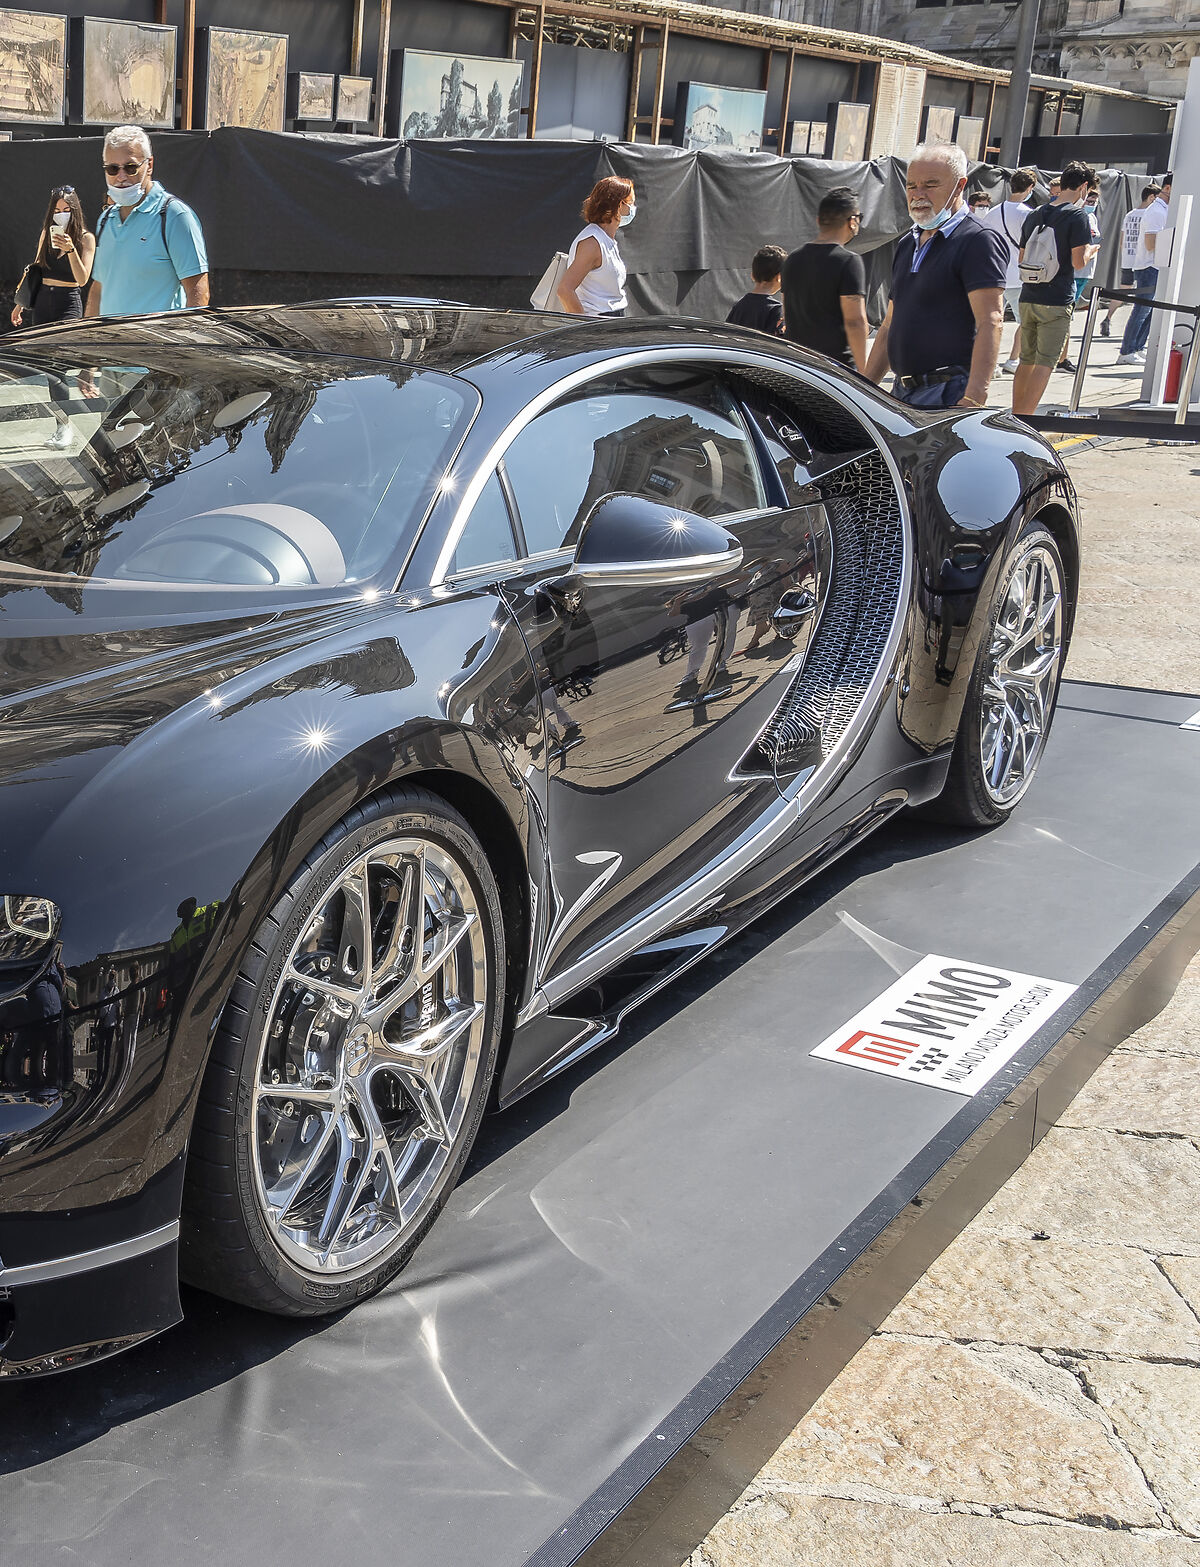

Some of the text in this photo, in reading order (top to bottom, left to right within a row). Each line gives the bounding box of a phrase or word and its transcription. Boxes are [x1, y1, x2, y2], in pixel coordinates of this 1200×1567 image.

[880, 967, 1012, 1040] MIMO
[941, 984, 1054, 1083] MILANO MONZA MOTOR SHOW
